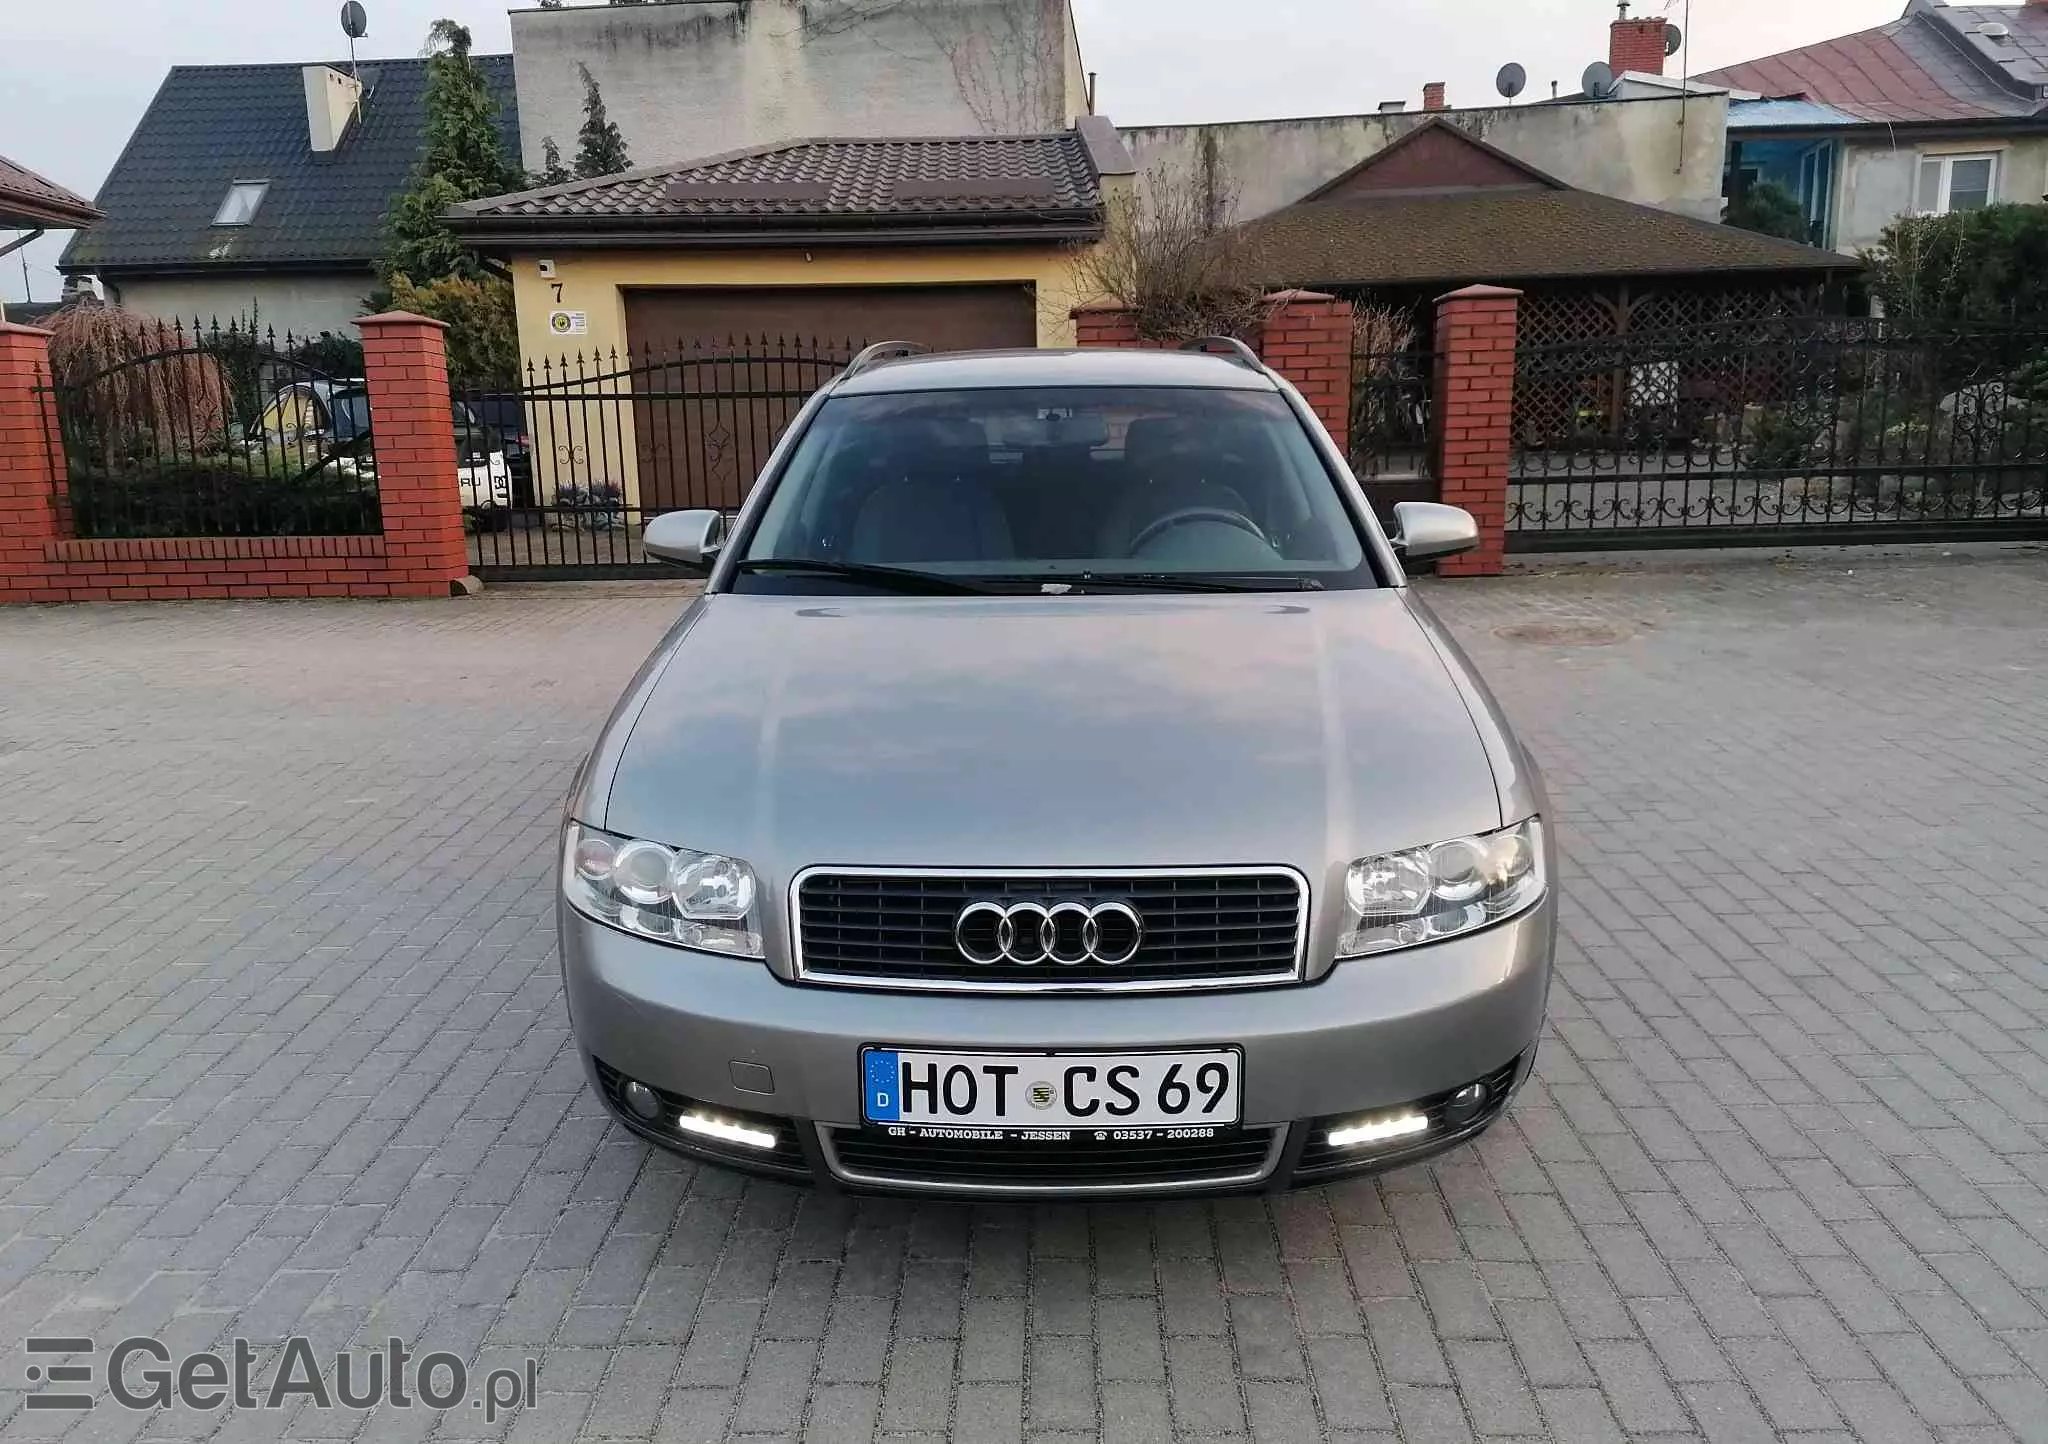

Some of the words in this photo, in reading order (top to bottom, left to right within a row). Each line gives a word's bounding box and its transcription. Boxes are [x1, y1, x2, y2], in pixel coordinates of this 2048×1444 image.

[551, 283, 562, 303] 7
[902, 1061, 1019, 1117] HOT
[1064, 1065, 1140, 1117] CS
[1158, 1062, 1229, 1115] 69
[877, 1092, 889, 1107] D
[888, 1127, 906, 1136] GH
[920, 1128, 1003, 1139] AUTOMOBILE
[1021, 1131, 1071, 1140] JESSEN
[1113, 1130, 1153, 1140] 03537
[1167, 1128, 1214, 1138] 200288
